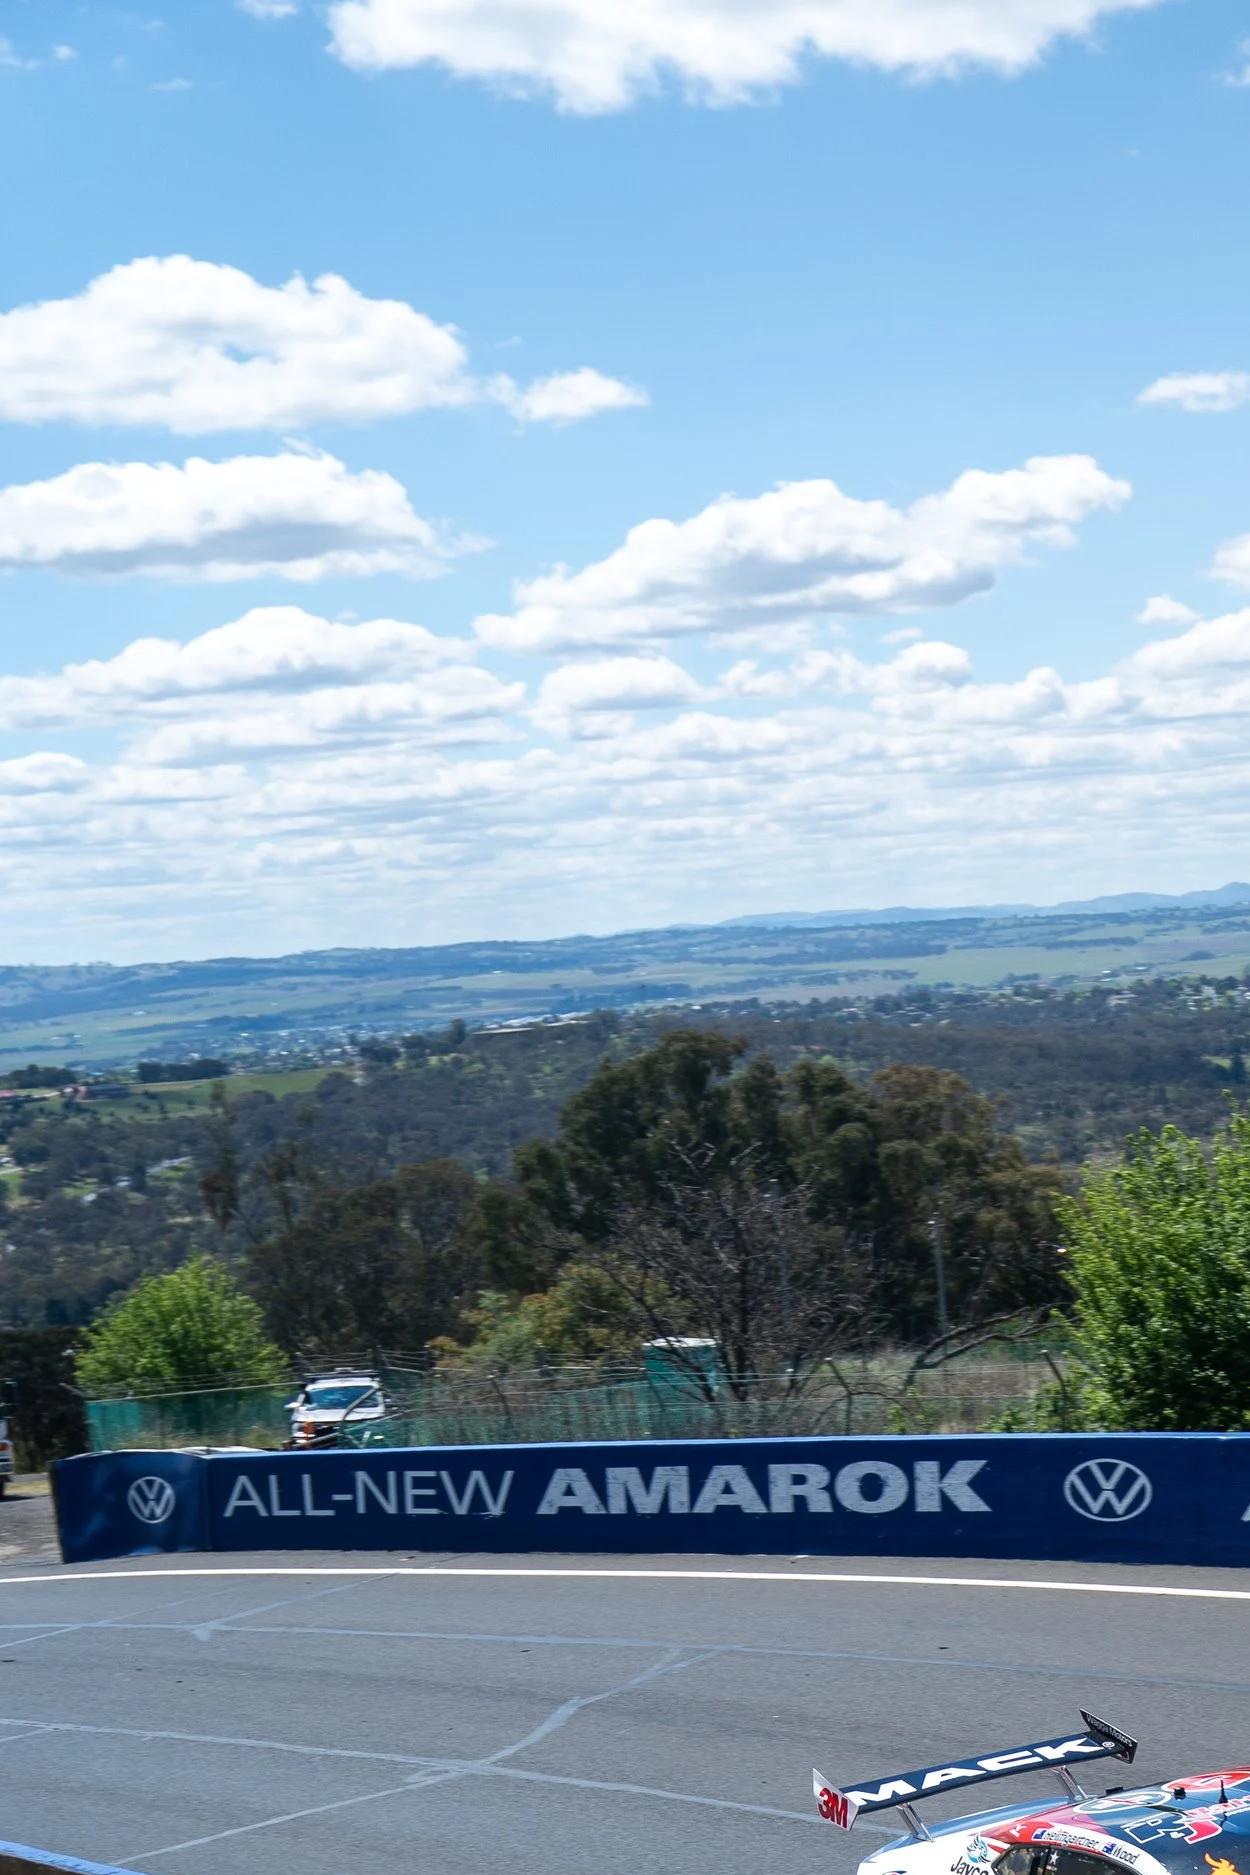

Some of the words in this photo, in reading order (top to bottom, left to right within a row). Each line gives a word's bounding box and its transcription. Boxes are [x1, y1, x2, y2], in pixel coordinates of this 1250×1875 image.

[223, 1469, 514, 1518] ALL-NEW
[536, 1460, 993, 1515] AMAROK
[844, 1738, 1104, 1806] MACK
[817, 1787, 850, 1829] 3M
